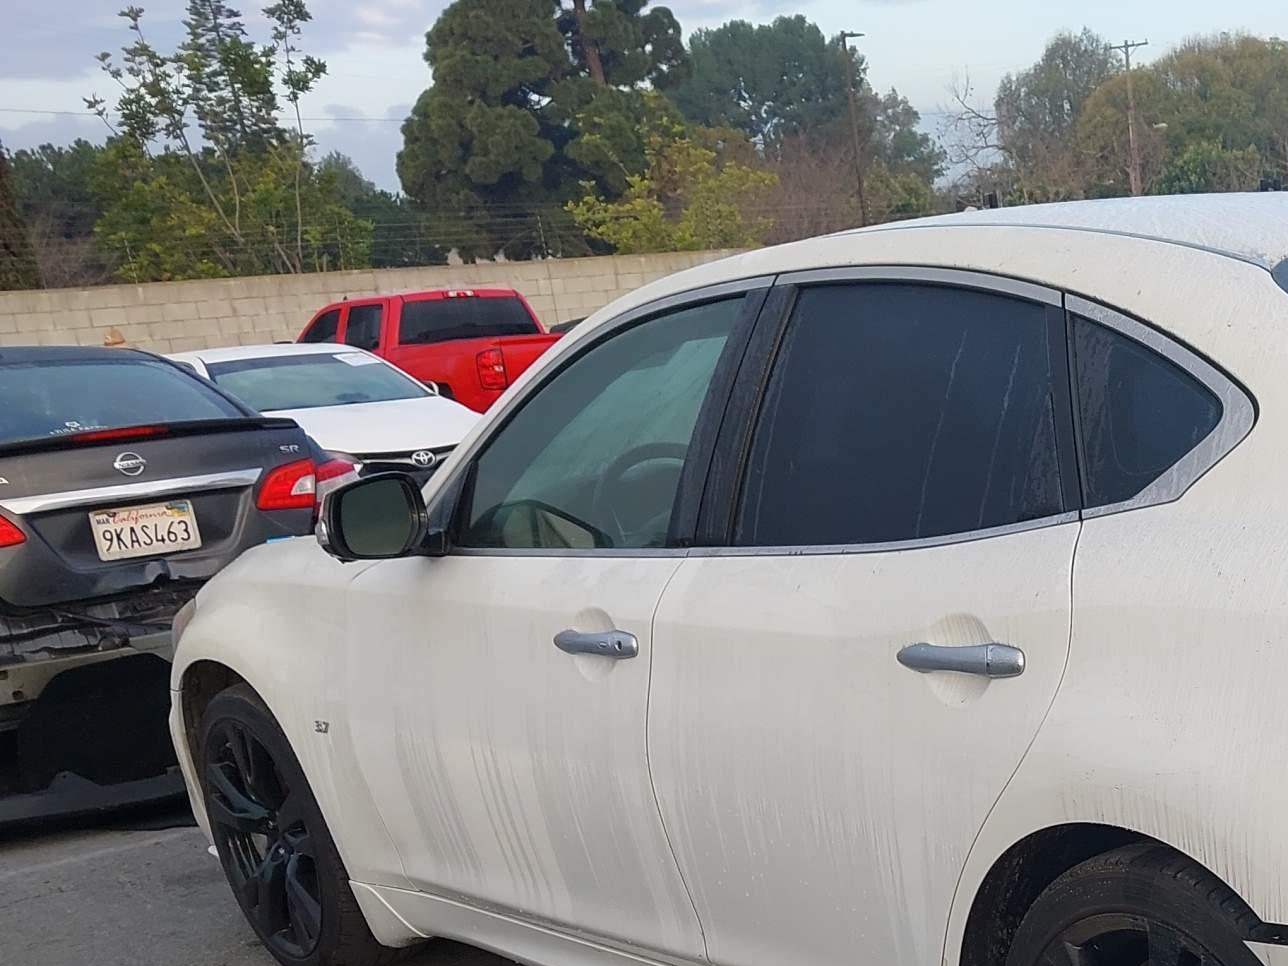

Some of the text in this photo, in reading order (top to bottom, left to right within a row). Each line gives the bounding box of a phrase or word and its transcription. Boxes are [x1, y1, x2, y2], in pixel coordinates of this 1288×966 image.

[279, 445, 300, 455] SR
[112, 510, 169, 525] California
[102, 519, 191, 552] 9KAS463
